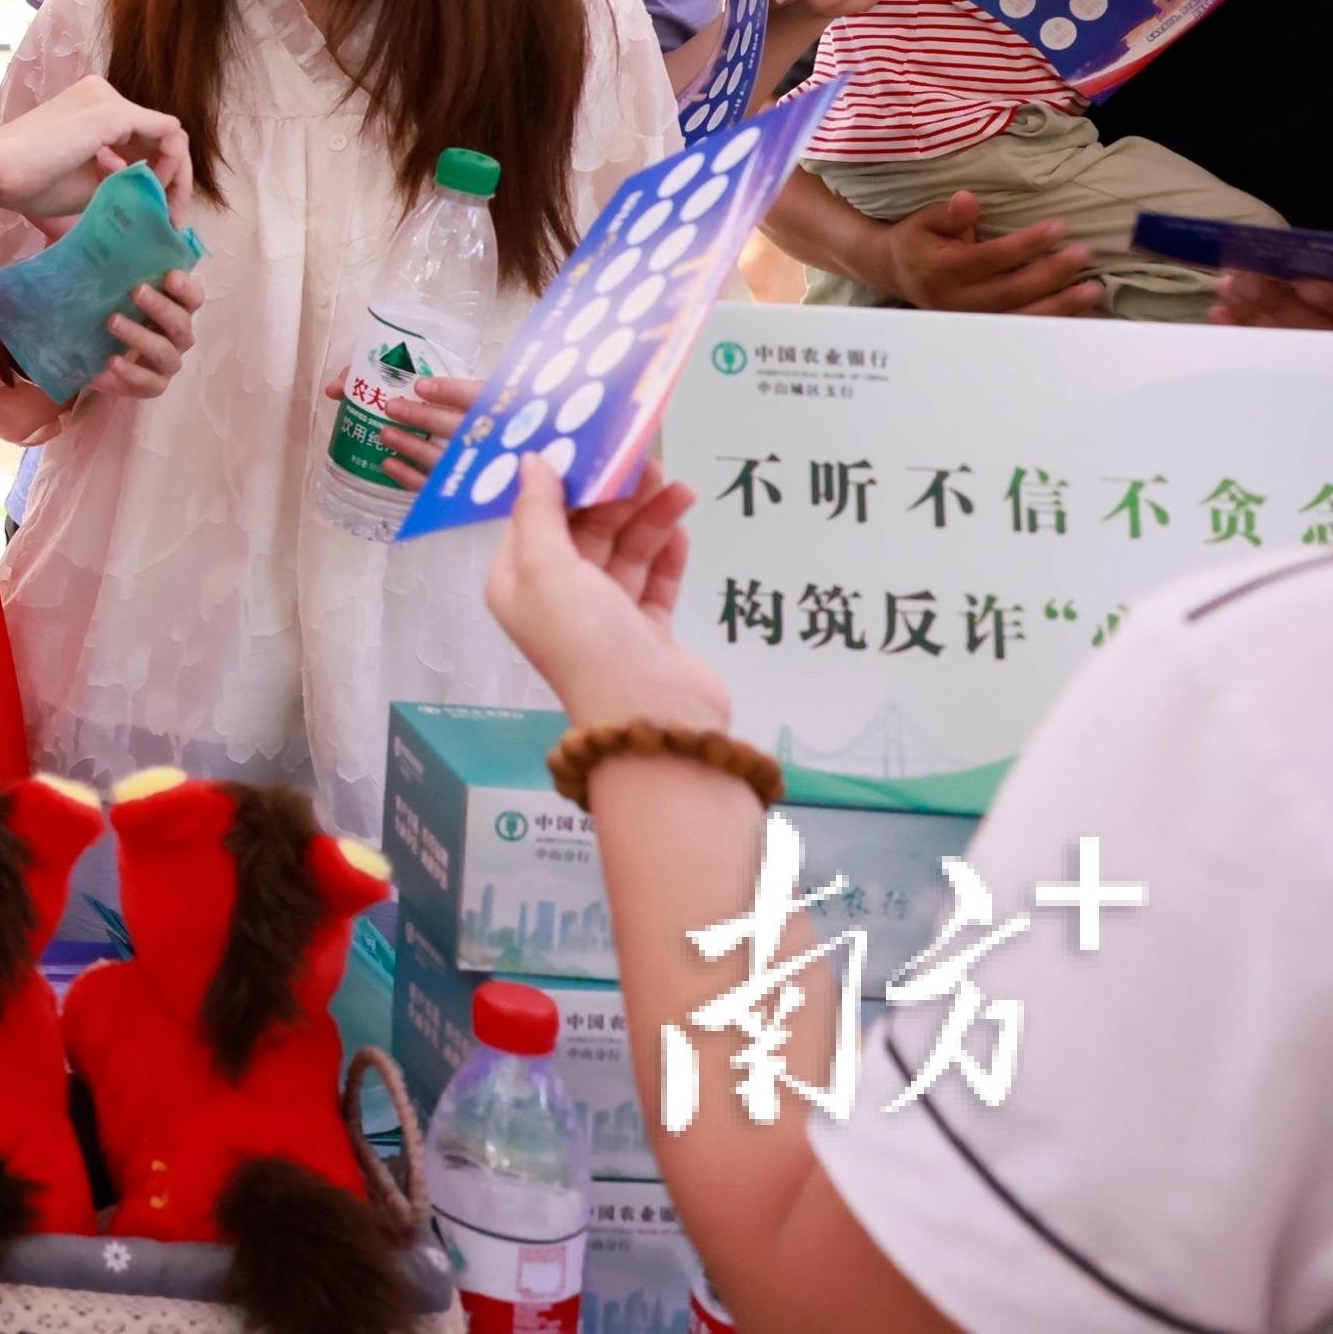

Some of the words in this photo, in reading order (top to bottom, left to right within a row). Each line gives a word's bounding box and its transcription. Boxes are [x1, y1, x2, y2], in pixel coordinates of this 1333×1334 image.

[754, 343, 890, 369] 中国农业银行
[340, 415, 399, 457] 饮用纯
[590, 1203, 677, 1224] 国农业银
